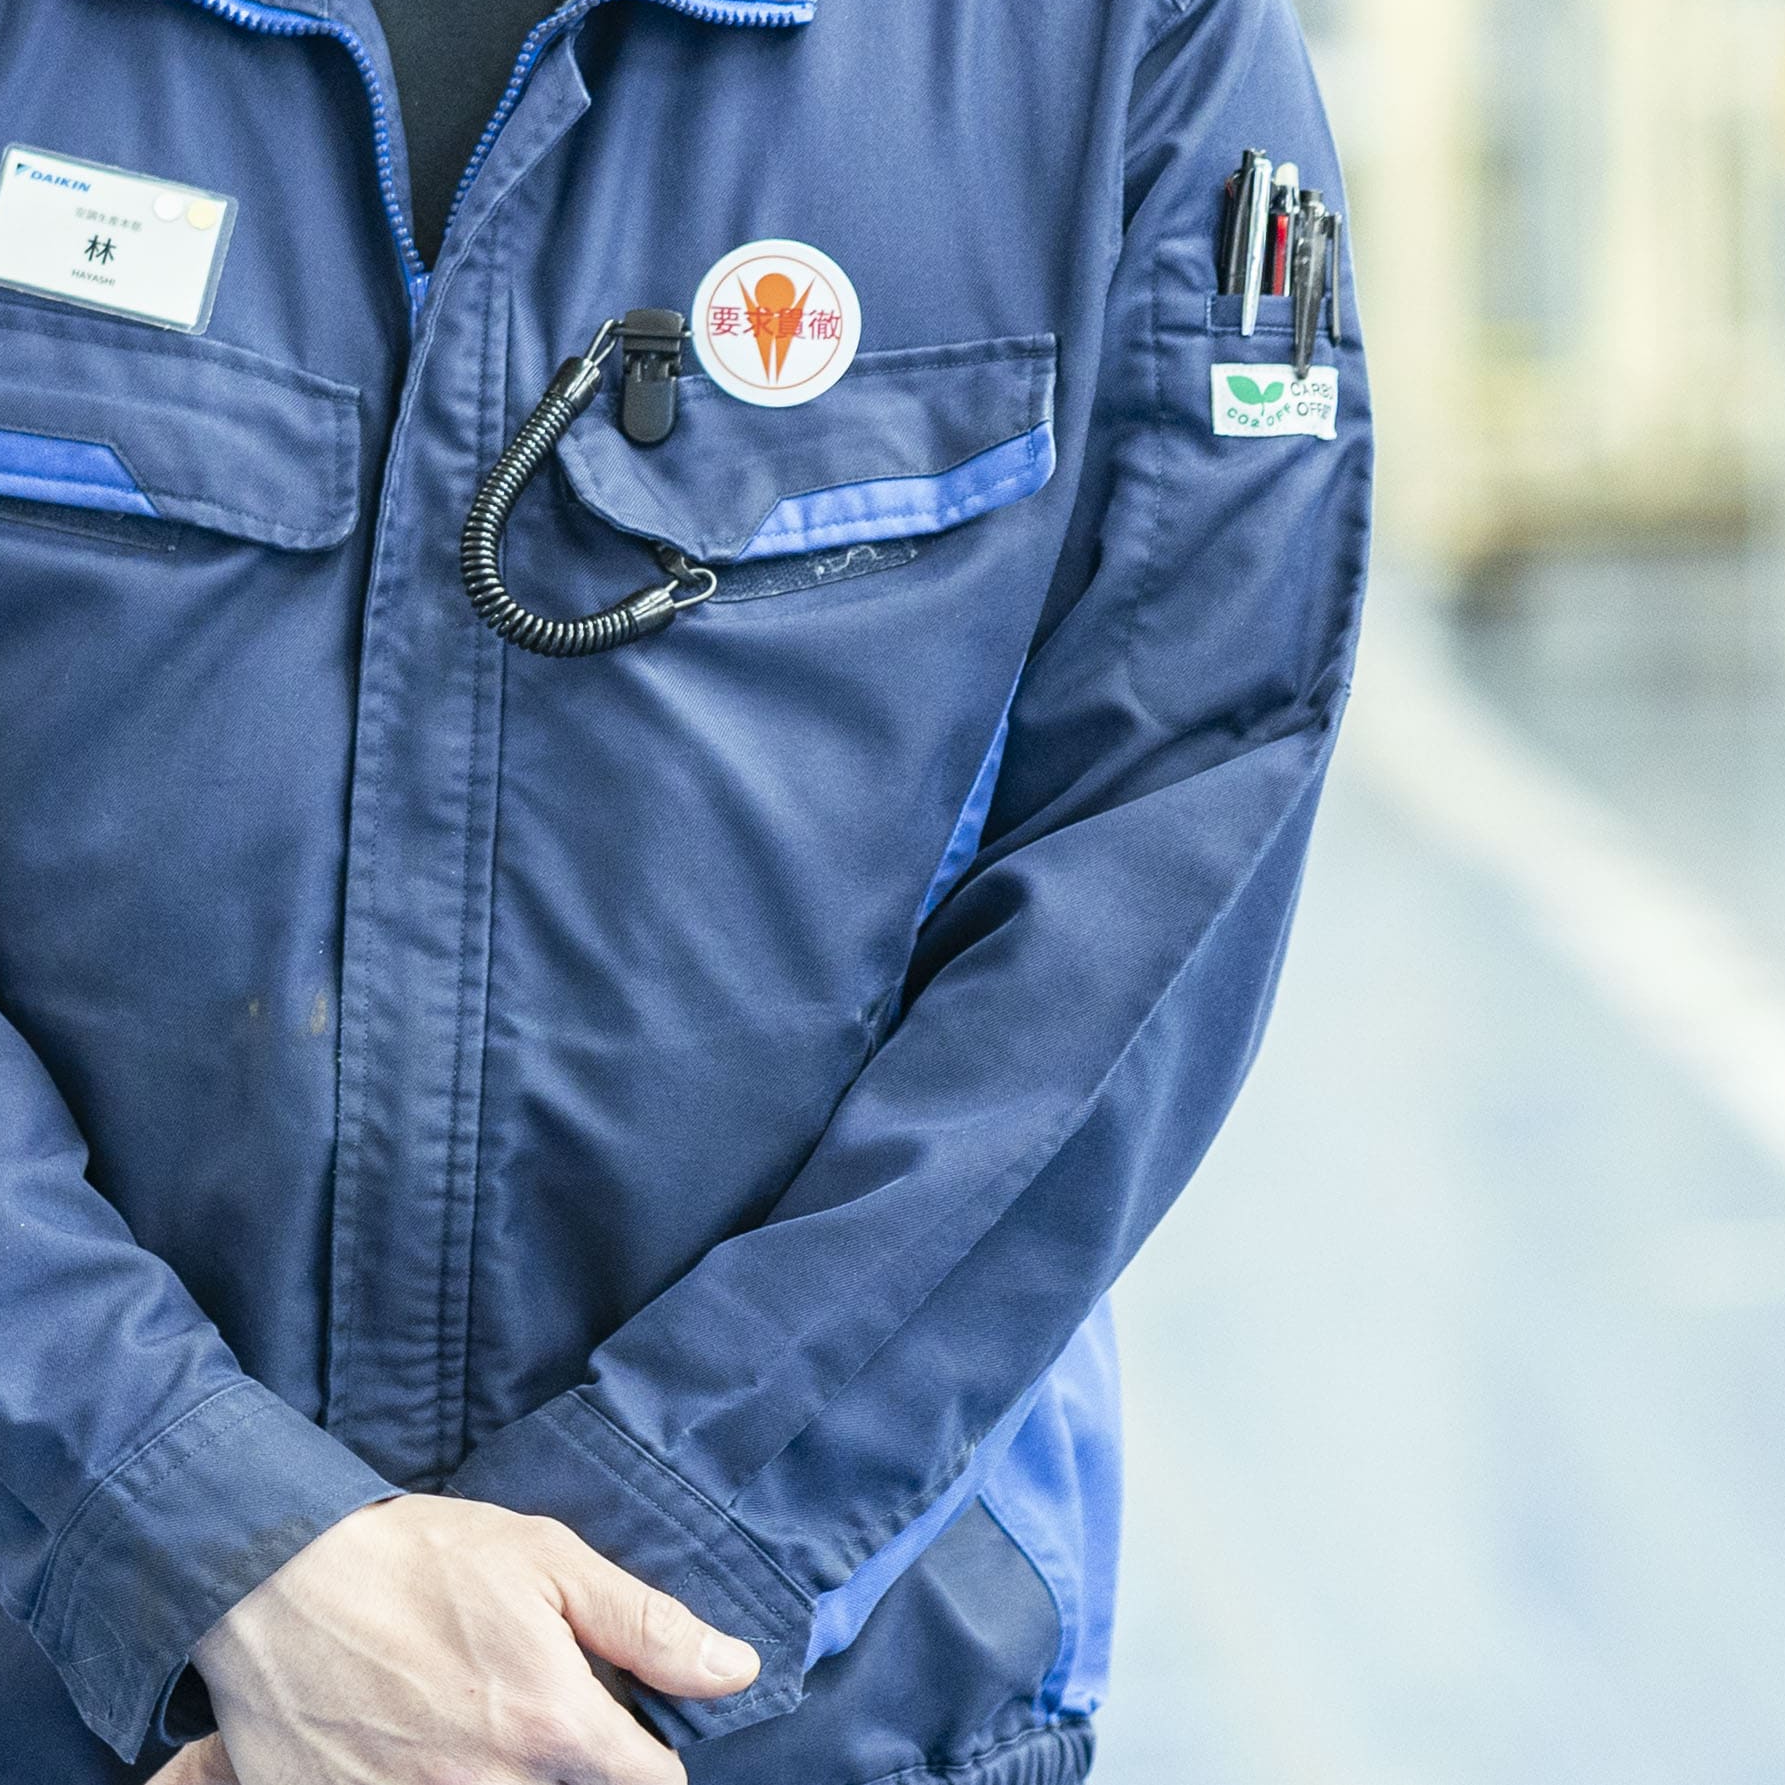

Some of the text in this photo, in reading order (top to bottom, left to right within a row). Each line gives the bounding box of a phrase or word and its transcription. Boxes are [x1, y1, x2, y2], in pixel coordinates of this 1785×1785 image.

[30, 170, 92, 192] DAIKIN
[84, 234, 117, 265] 林
[72, 269, 116, 287] HAYASHI
[1226, 407, 1260, 427] CO2
